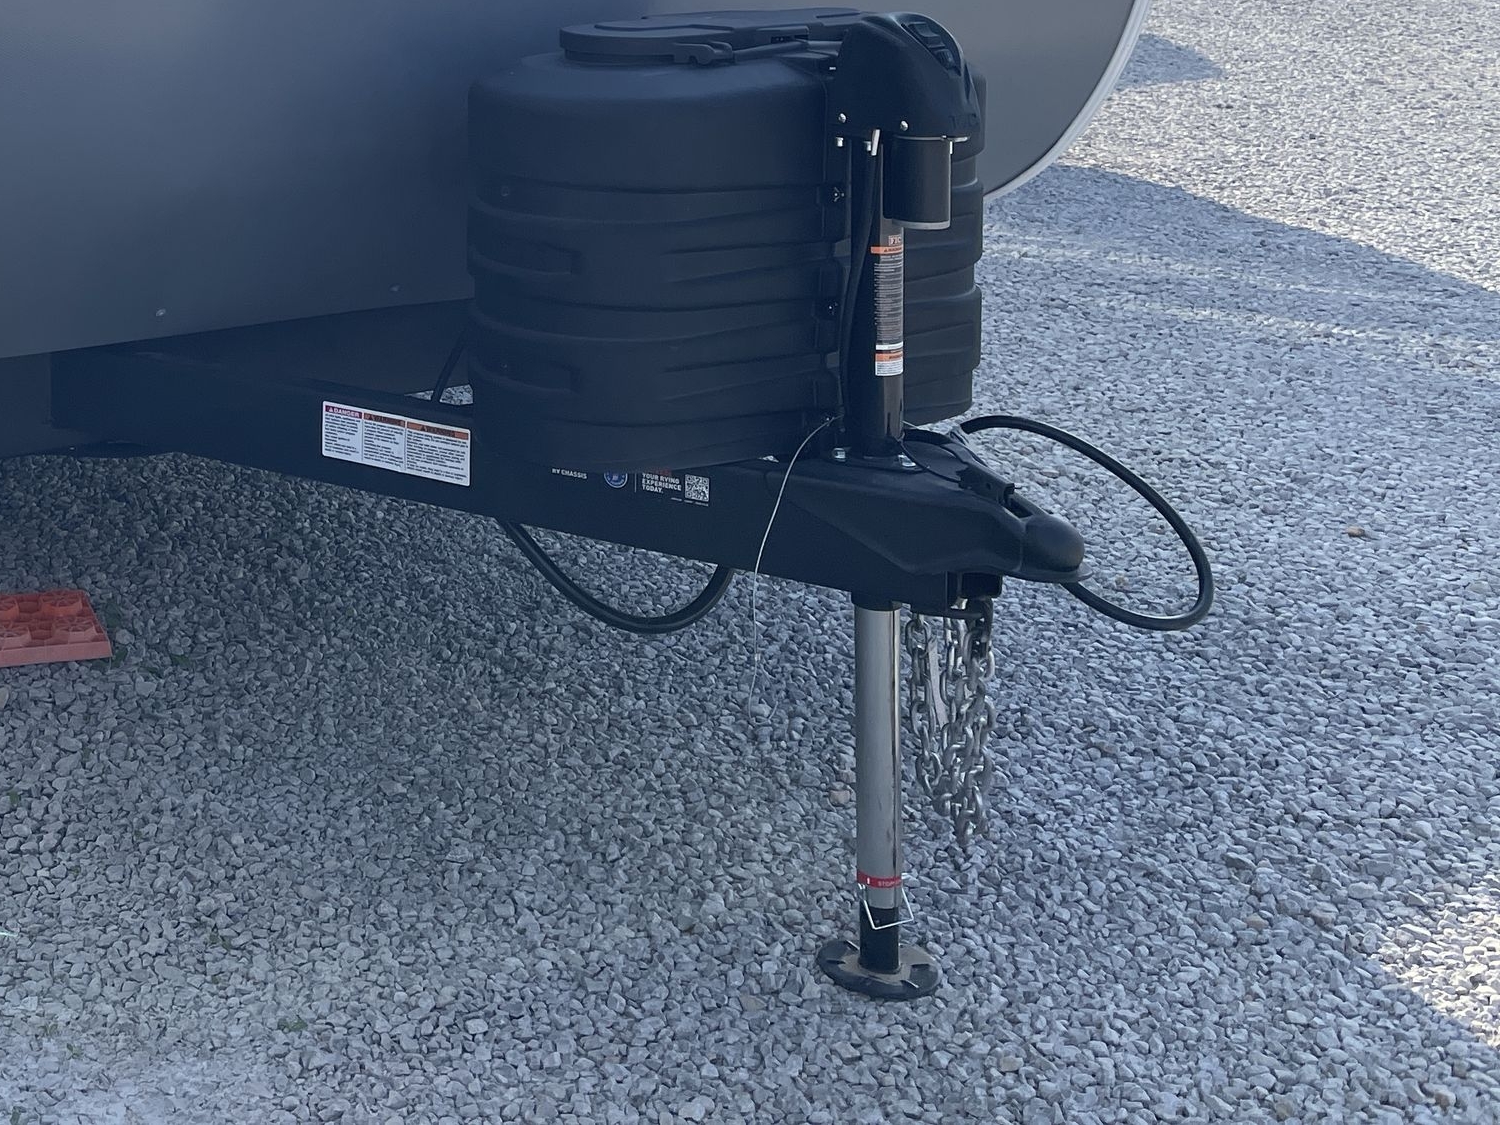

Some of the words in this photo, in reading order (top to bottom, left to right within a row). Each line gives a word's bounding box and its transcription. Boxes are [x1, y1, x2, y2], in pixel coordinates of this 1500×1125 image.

[333, 406, 360, 418] DANGER
[561, 469, 588, 480] CHASSIS
[642, 472, 659, 481] YOUR
[642, 478, 682, 491] EXPERIENCE
[642, 484, 664, 494] TODAY.
